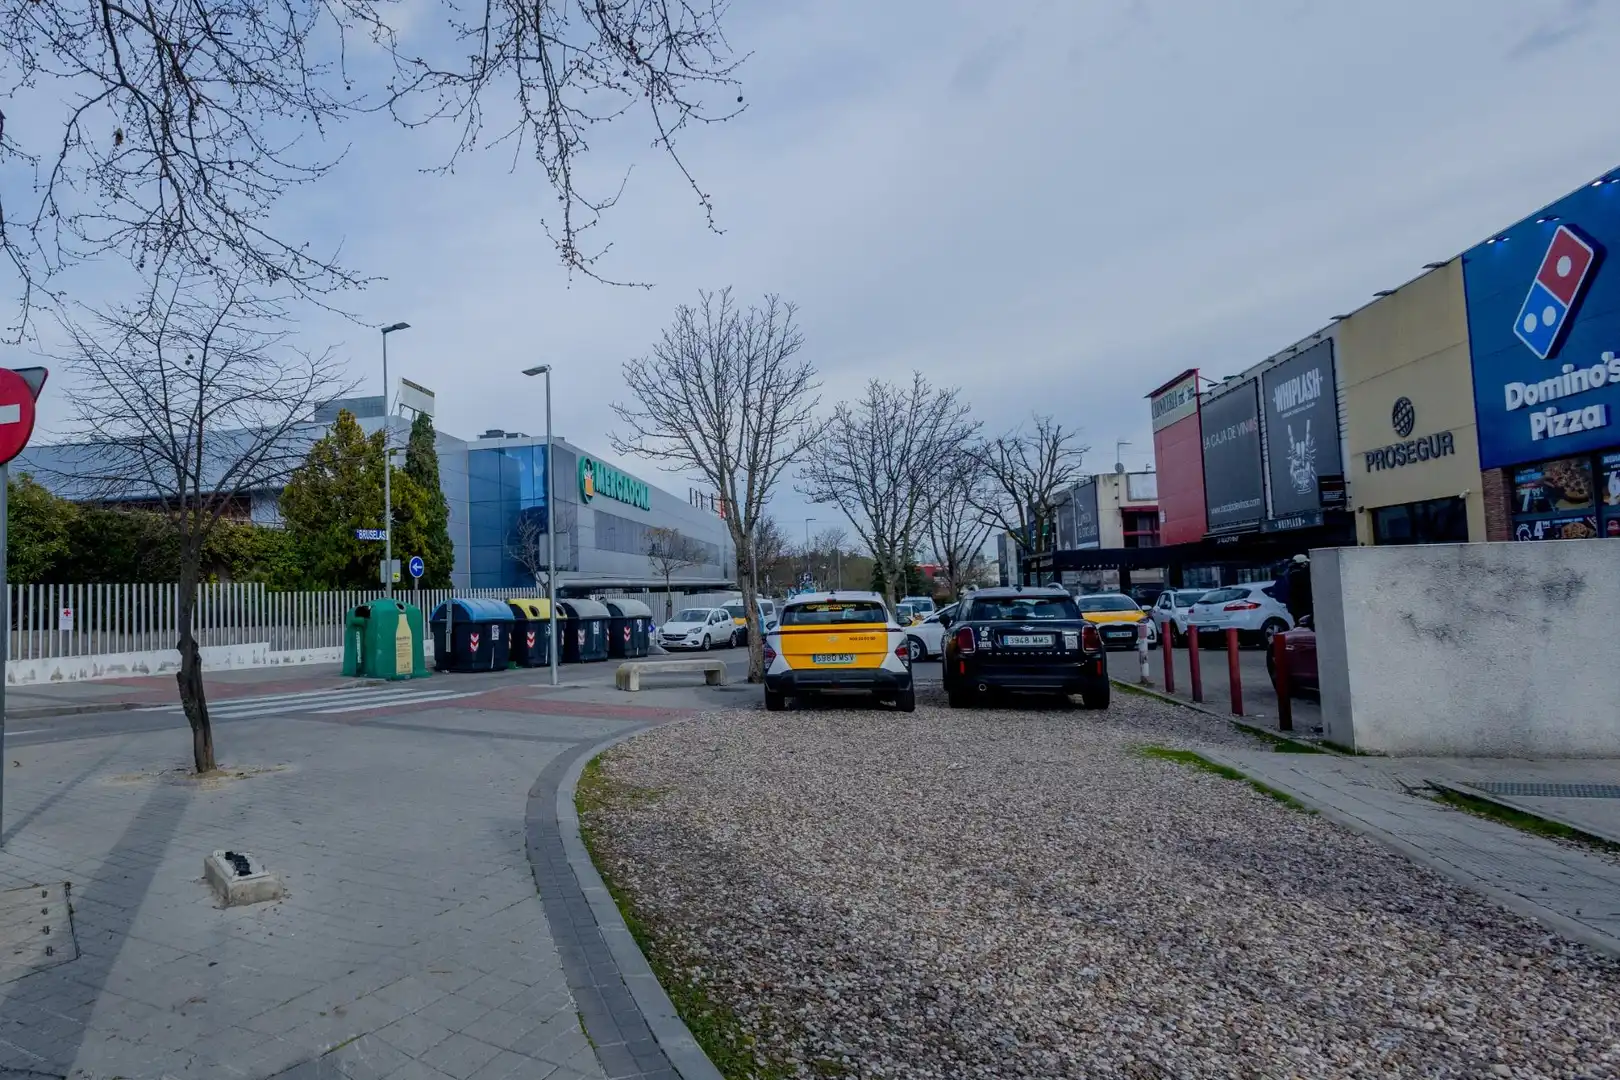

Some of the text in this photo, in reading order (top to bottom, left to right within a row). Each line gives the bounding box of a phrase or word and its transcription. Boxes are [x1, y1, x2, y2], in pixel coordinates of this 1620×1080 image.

[1273, 367, 1322, 413] WHIPLASH
[1504, 351, 1620, 412] Domino's
[1203, 435, 1210, 451] LA
[1211, 429, 1227, 447] CAJA
[1228, 425, 1236, 440] DE
[1529, 404, 1607, 441] Pizza
[1366, 431, 1455, 473] PROSEGUR
[359, 530, 386, 540] BRUSELAS
[1534, 521, 1544, 539] 4
